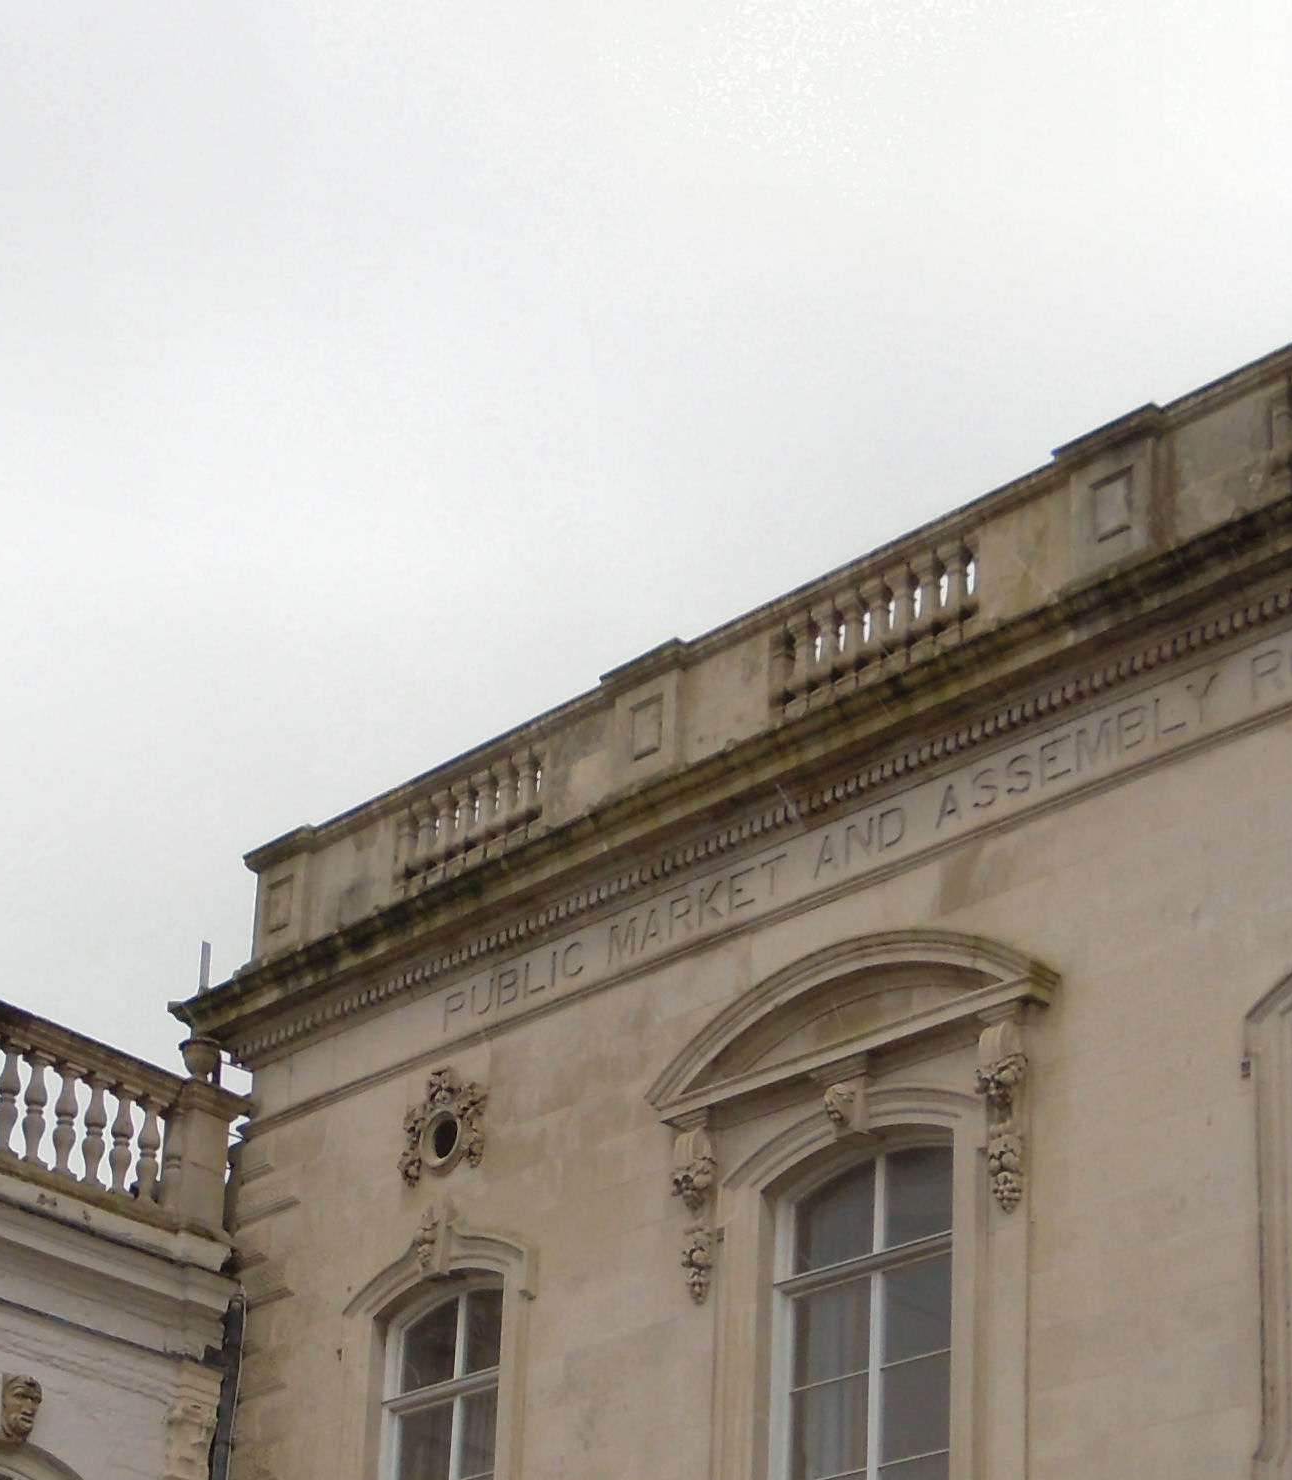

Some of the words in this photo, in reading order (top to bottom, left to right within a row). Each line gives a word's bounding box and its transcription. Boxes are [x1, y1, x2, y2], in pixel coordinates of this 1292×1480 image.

[443, 941, 585, 1033] PUBLIC
[608, 853, 788, 965] MARKET
[813, 807, 906, 880] AND
[935, 673, 1220, 830] ASSEMBLY
